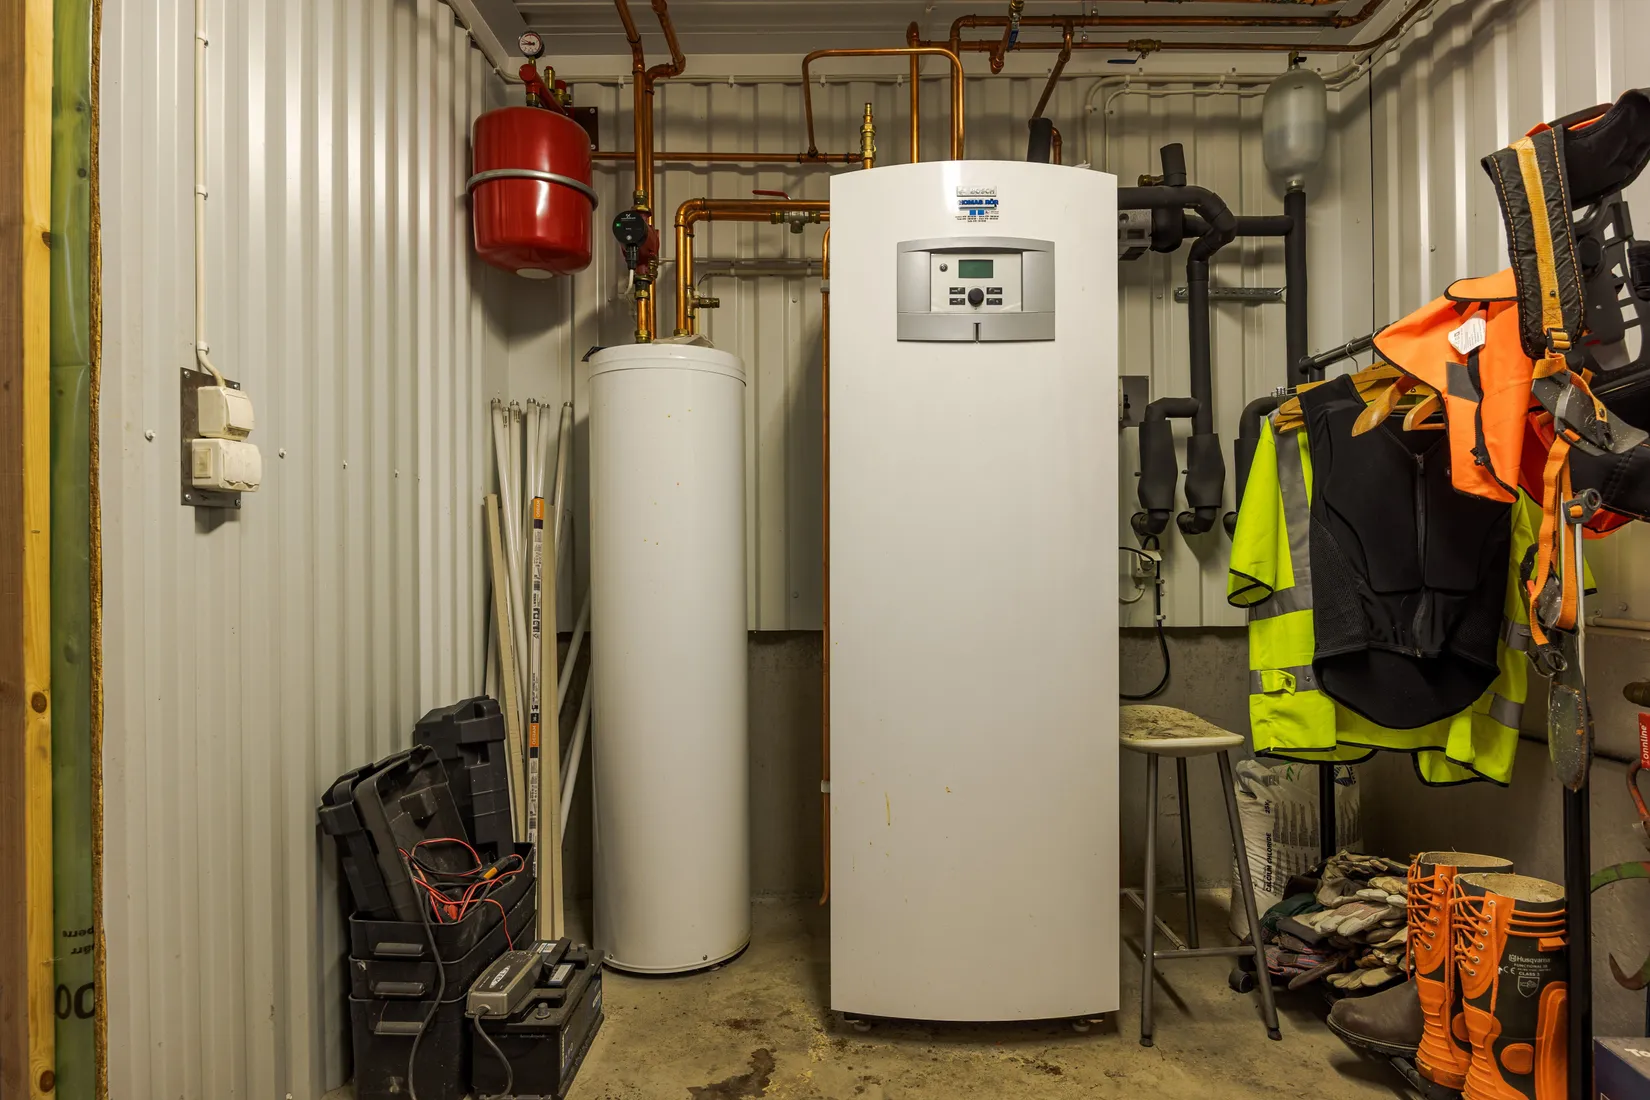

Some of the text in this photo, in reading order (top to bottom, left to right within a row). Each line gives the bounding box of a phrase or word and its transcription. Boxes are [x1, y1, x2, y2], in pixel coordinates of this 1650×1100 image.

[1265, 831, 1273, 893] CALCIUM CHLORIDE
[1516, 955, 1551, 964] Husqvarna
